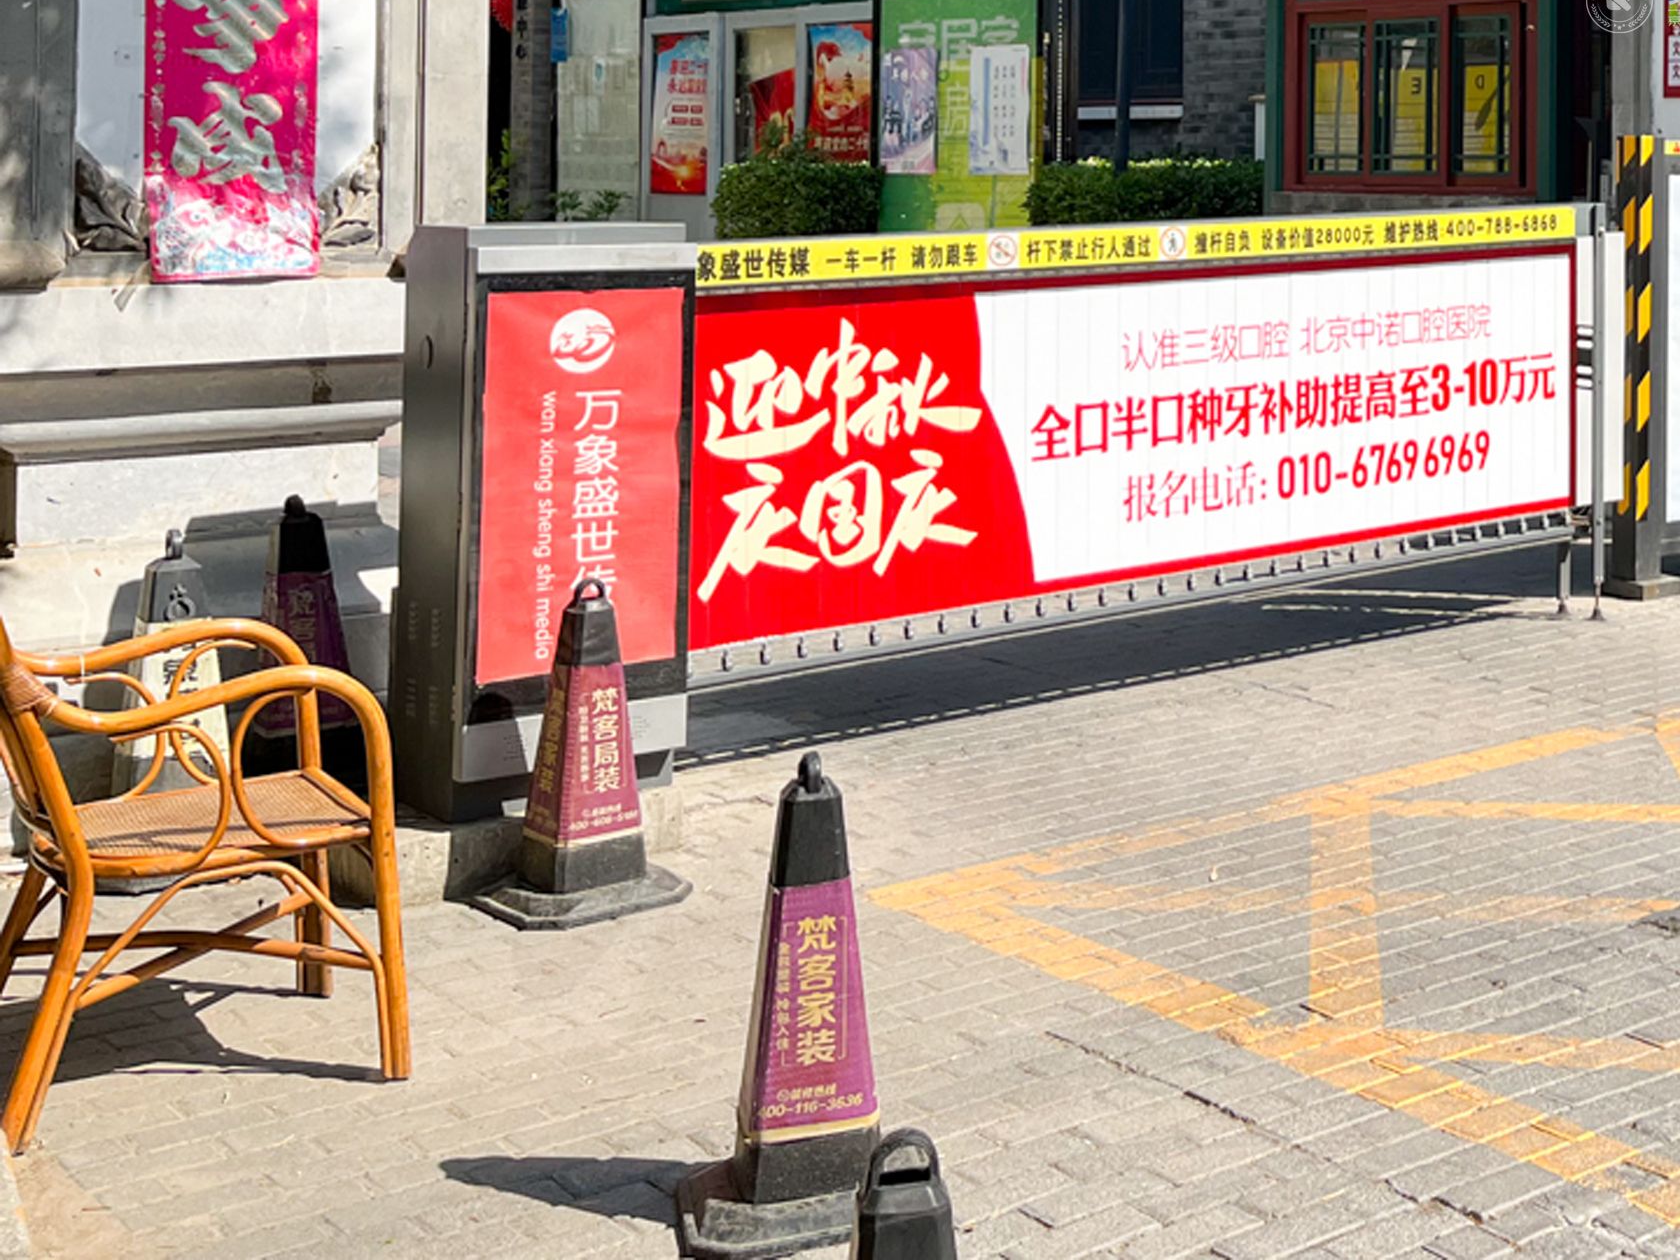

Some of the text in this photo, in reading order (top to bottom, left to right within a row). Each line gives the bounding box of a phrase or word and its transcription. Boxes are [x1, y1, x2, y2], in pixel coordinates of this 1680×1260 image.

[697, 247, 811, 282] 象盛世传媒
[826, 247, 897, 273] 一车一杆
[912, 242, 978, 270] 请勿跟车
[1027, 234, 1152, 263] 杆下禁止行人通过
[1194, 228, 1252, 254] 撞杆自负
[1260, 224, 1375, 253] 设备价值28000元
[702, 318, 982, 460] 迎中秋
[1030, 352, 1556, 462] 全口半口种牙补助提高至3-10万元
[1121, 303, 1492, 372] 认准三级口腔 北京中诺口腔医院
[532, 392, 557, 660] wan xiang sheng shi media
[697, 449, 979, 603] 庆国庆
[796, 915, 837, 1067] 梵客家装
